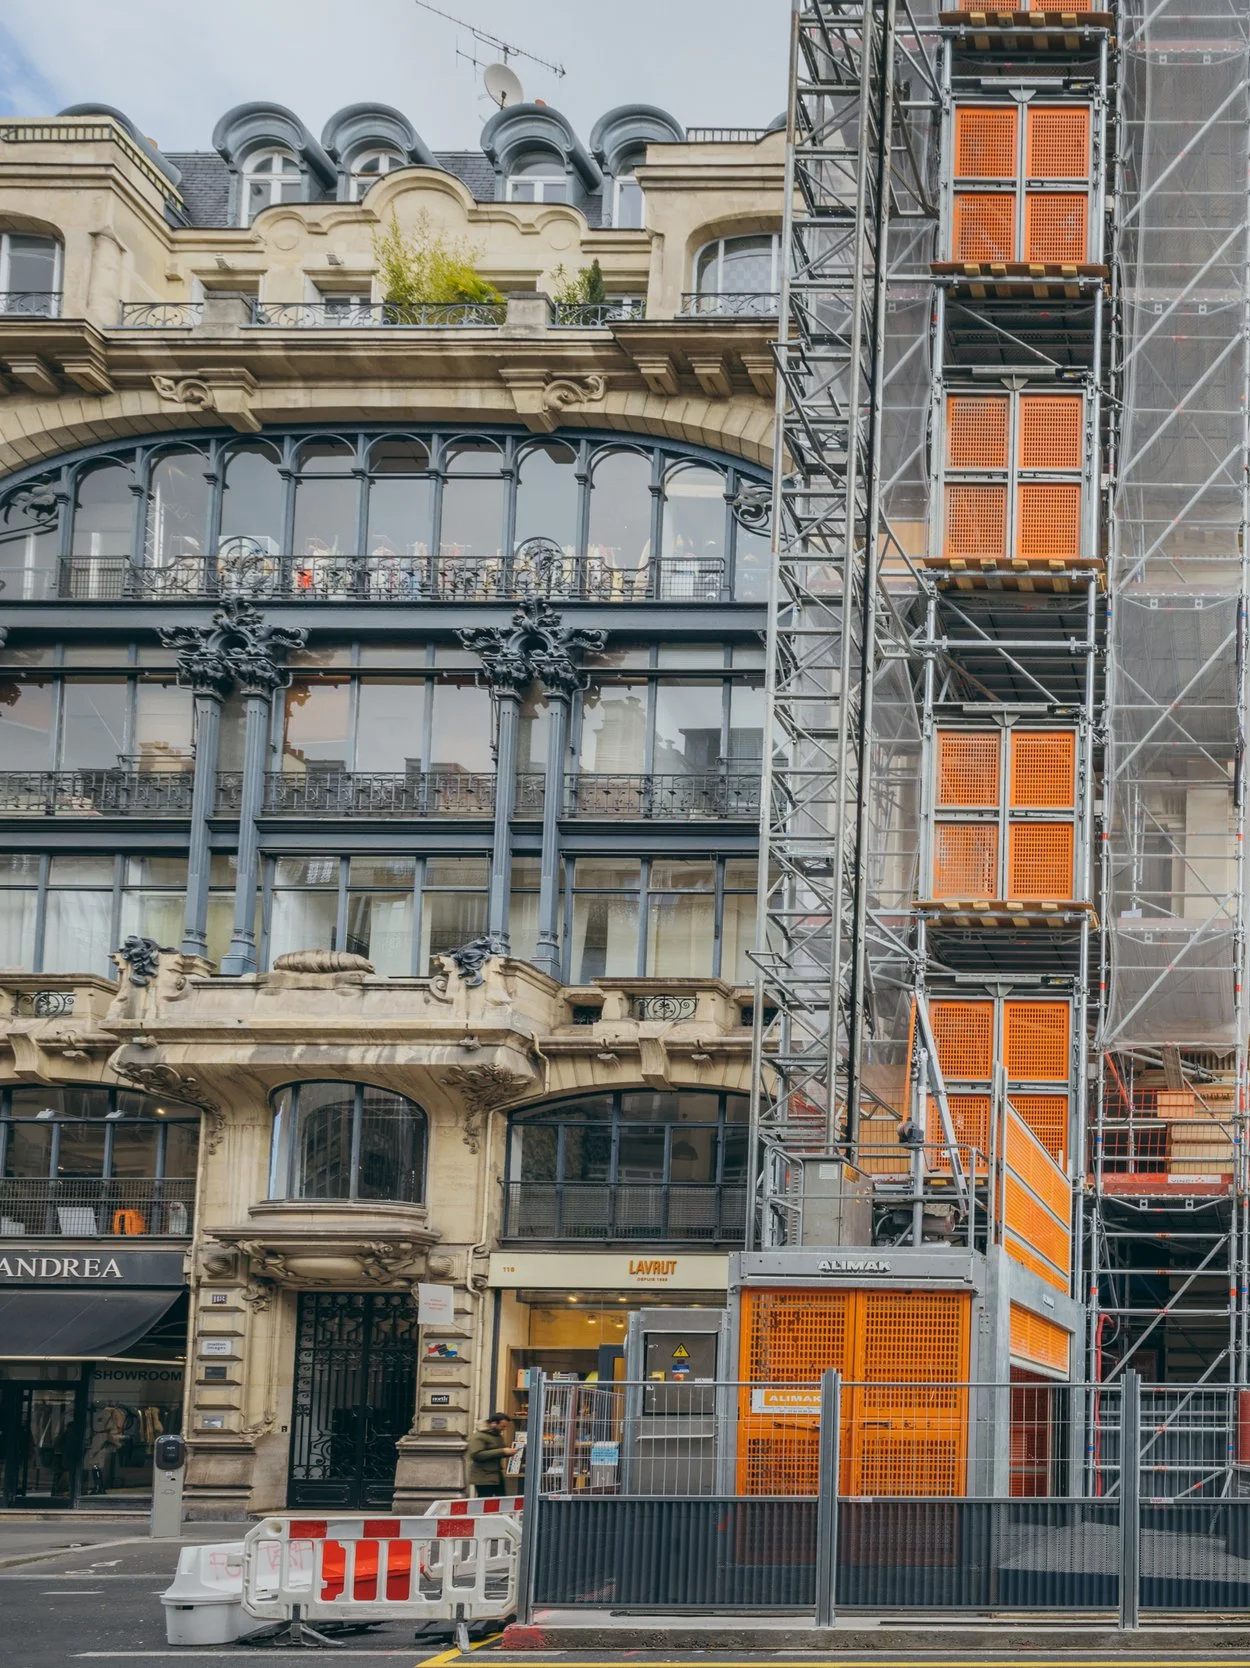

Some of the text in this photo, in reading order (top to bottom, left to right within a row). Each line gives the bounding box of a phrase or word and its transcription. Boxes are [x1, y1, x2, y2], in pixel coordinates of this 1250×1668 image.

[0, 1257, 124, 1278] ANDREA
[628, 1260, 677, 1275] LAVRUT
[817, 1260, 892, 1271] ALIMAK
[93, 1370, 182, 1381] SHOWROOM
[768, 1394, 822, 1403] ALIMAK
